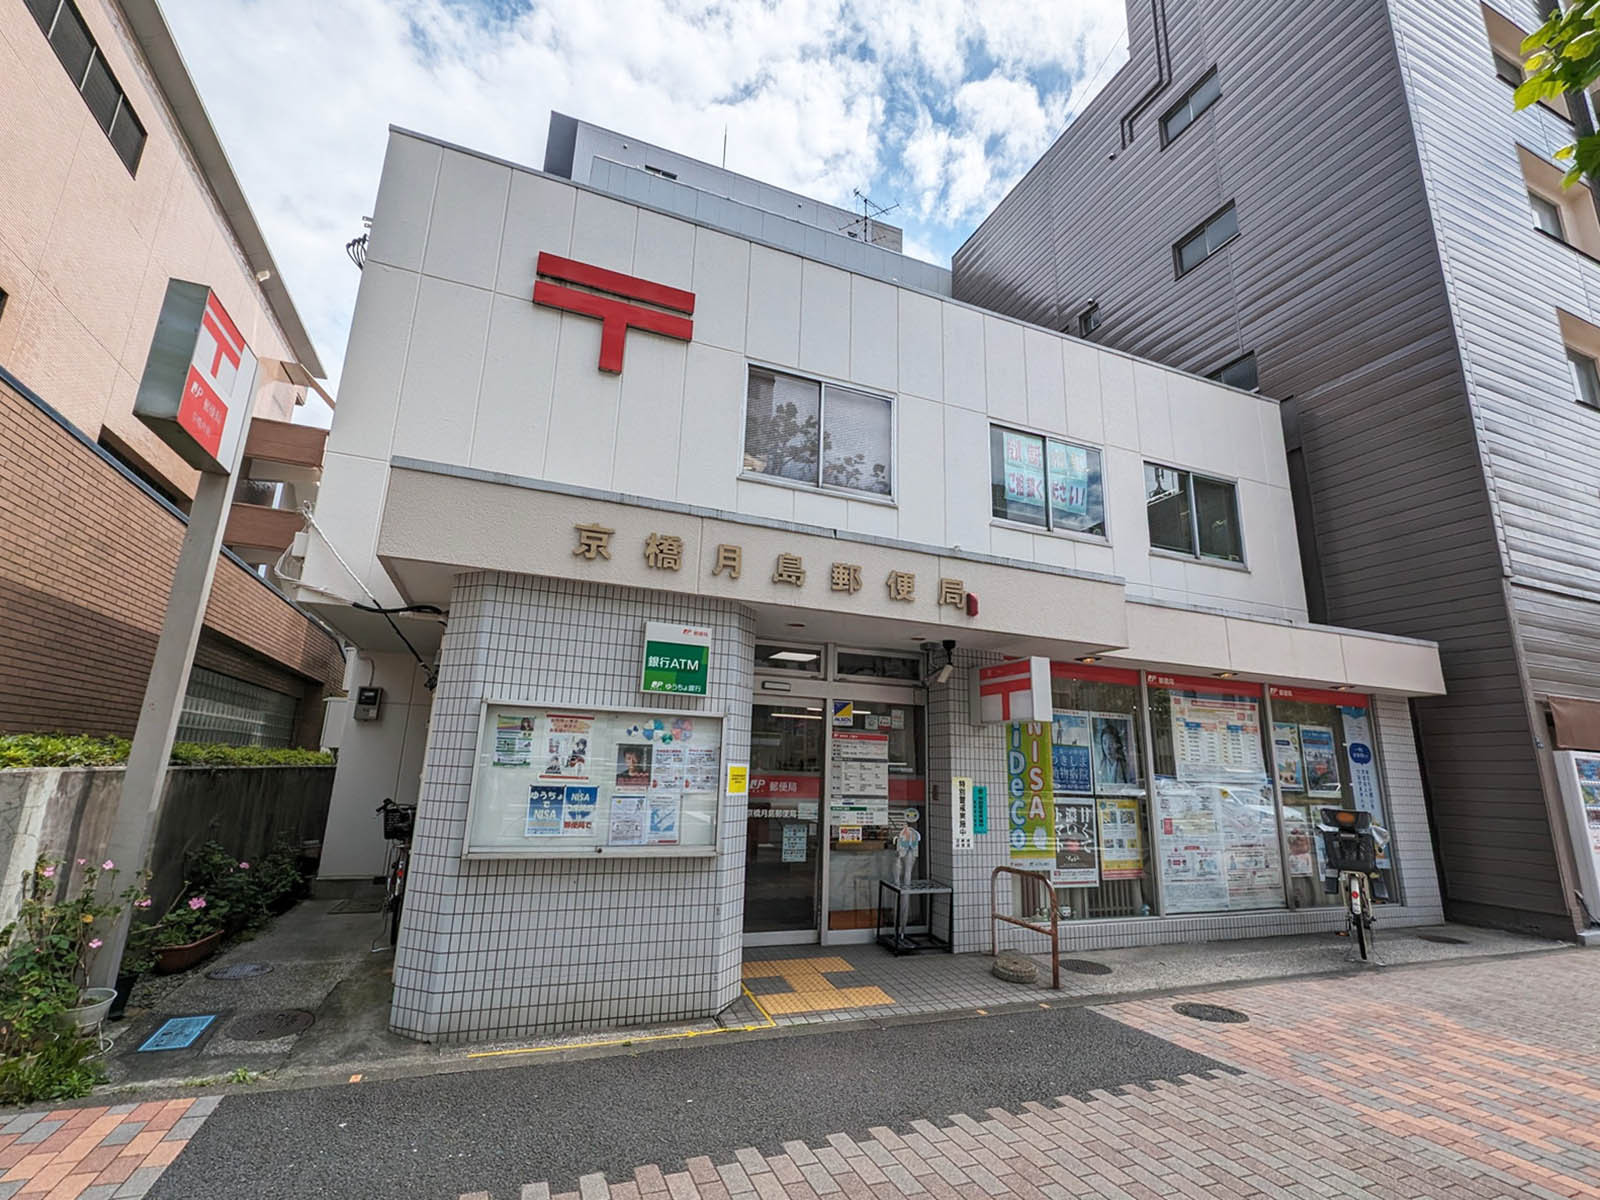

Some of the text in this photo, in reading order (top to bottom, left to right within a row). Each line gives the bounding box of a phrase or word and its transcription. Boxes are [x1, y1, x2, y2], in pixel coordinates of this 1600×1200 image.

[572, 523, 965, 609] 京橋月島郵便局
[647, 655, 700, 671] 銀行ATM
[665, 682, 702, 693] ゆうちょ銀行
[1026, 721, 1047, 820] NISA
[769, 781, 797, 792] 郵便局
[1008, 721, 1027, 850] iDeCo
[529, 790, 563, 801] ゆうちょ
[570, 792, 591, 802] NISA
[534, 808, 557, 819] NISA
